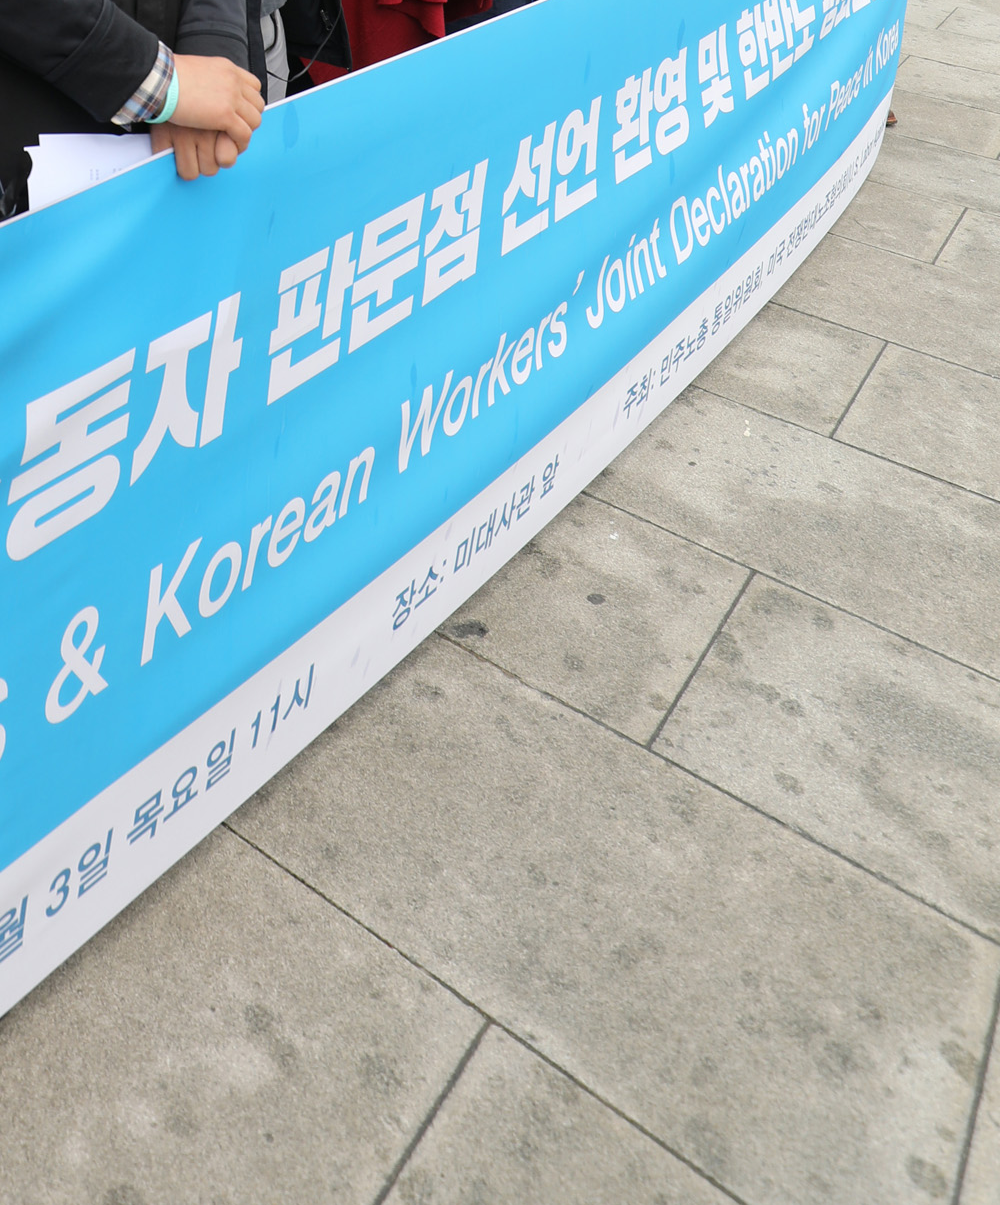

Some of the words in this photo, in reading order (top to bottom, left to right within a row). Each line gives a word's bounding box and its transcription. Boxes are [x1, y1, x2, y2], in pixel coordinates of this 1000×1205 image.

[44, 606, 109, 724] &
[140, 446, 376, 667] Korean
[585, 217, 667, 329] Joint
[669, 127, 799, 265] Declaration
[801, 103, 826, 155] for
[824, 64, 864, 131] Peace
[863, 45, 874, 88] in
[875, 18, 899, 75] Korea
[267, 158, 489, 406] 판문점
[501, 95, 602, 257] 선언
[612, 47, 690, 185] 환영
[696, 23, 735, 129] 및
[45, 827, 114, 918] 3일
[126, 727, 236, 845] 목요일
[250, 663, 315, 749] 11시
[392, 558, 447, 631] 장소:
[453, 475, 535, 575] 미대사관
[540, 454, 561, 499] 앞
[623, 368, 656, 420] 주최:
[660, 317, 709, 387] 민주노총
[767, 239, 786, 277] 미국
